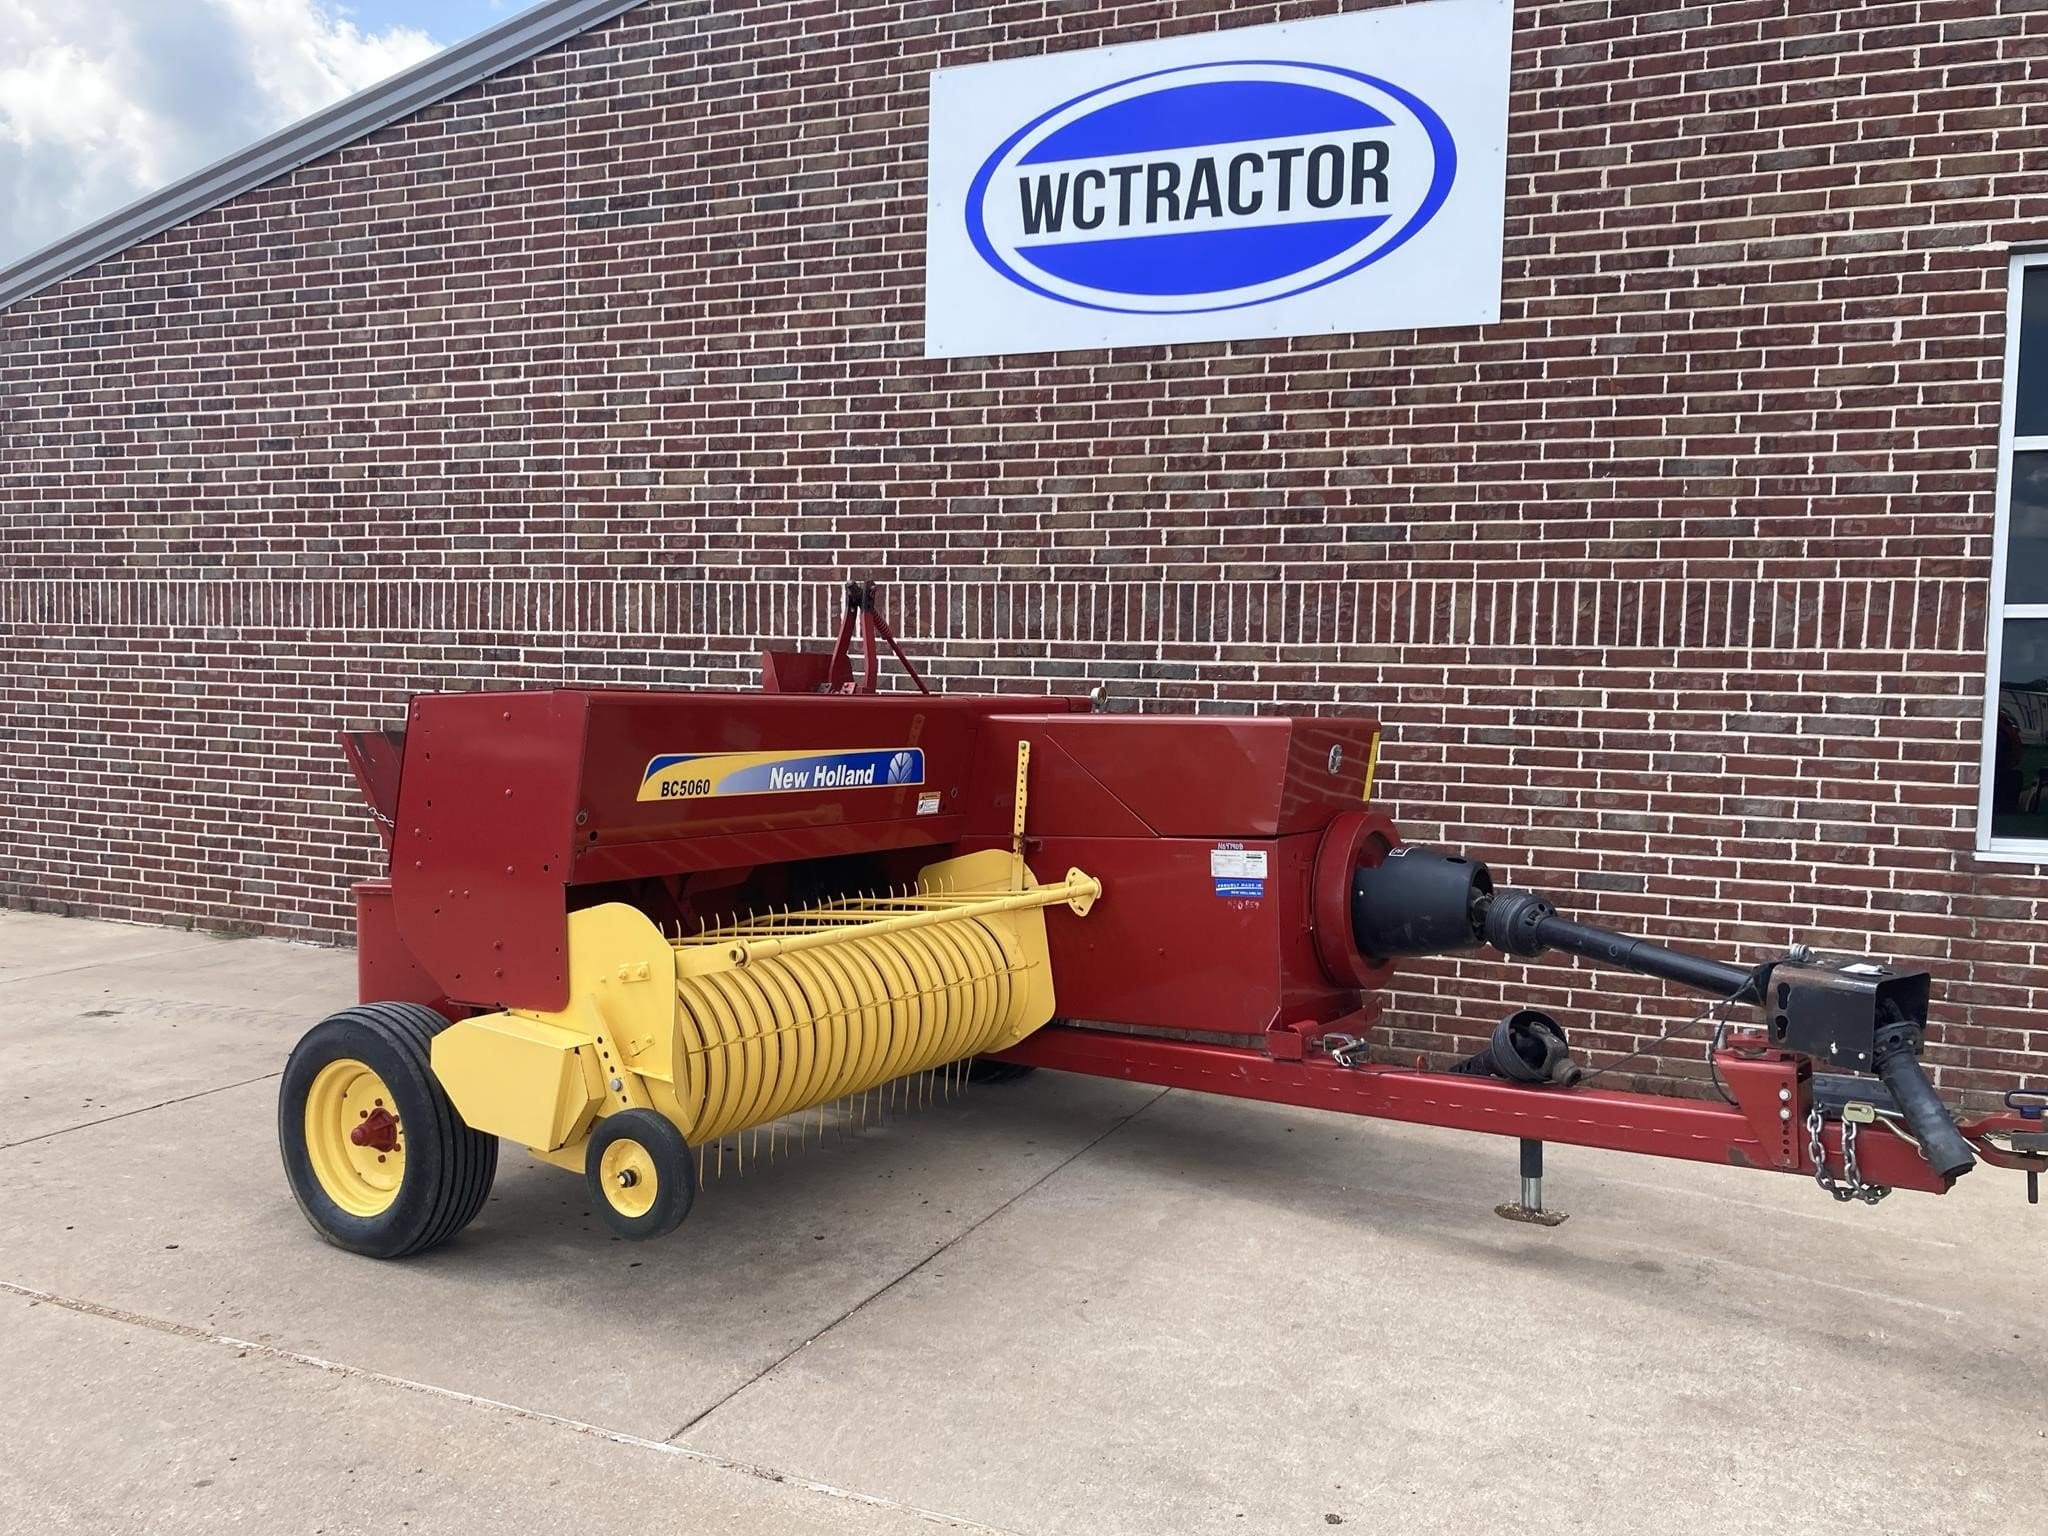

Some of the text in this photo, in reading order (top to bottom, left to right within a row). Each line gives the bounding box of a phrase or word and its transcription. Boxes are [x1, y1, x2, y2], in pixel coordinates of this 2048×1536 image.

[1018, 139, 1391, 235] WCTRACTOR
[661, 778, 710, 798] BC5060
[769, 763, 875, 790] New Holland
